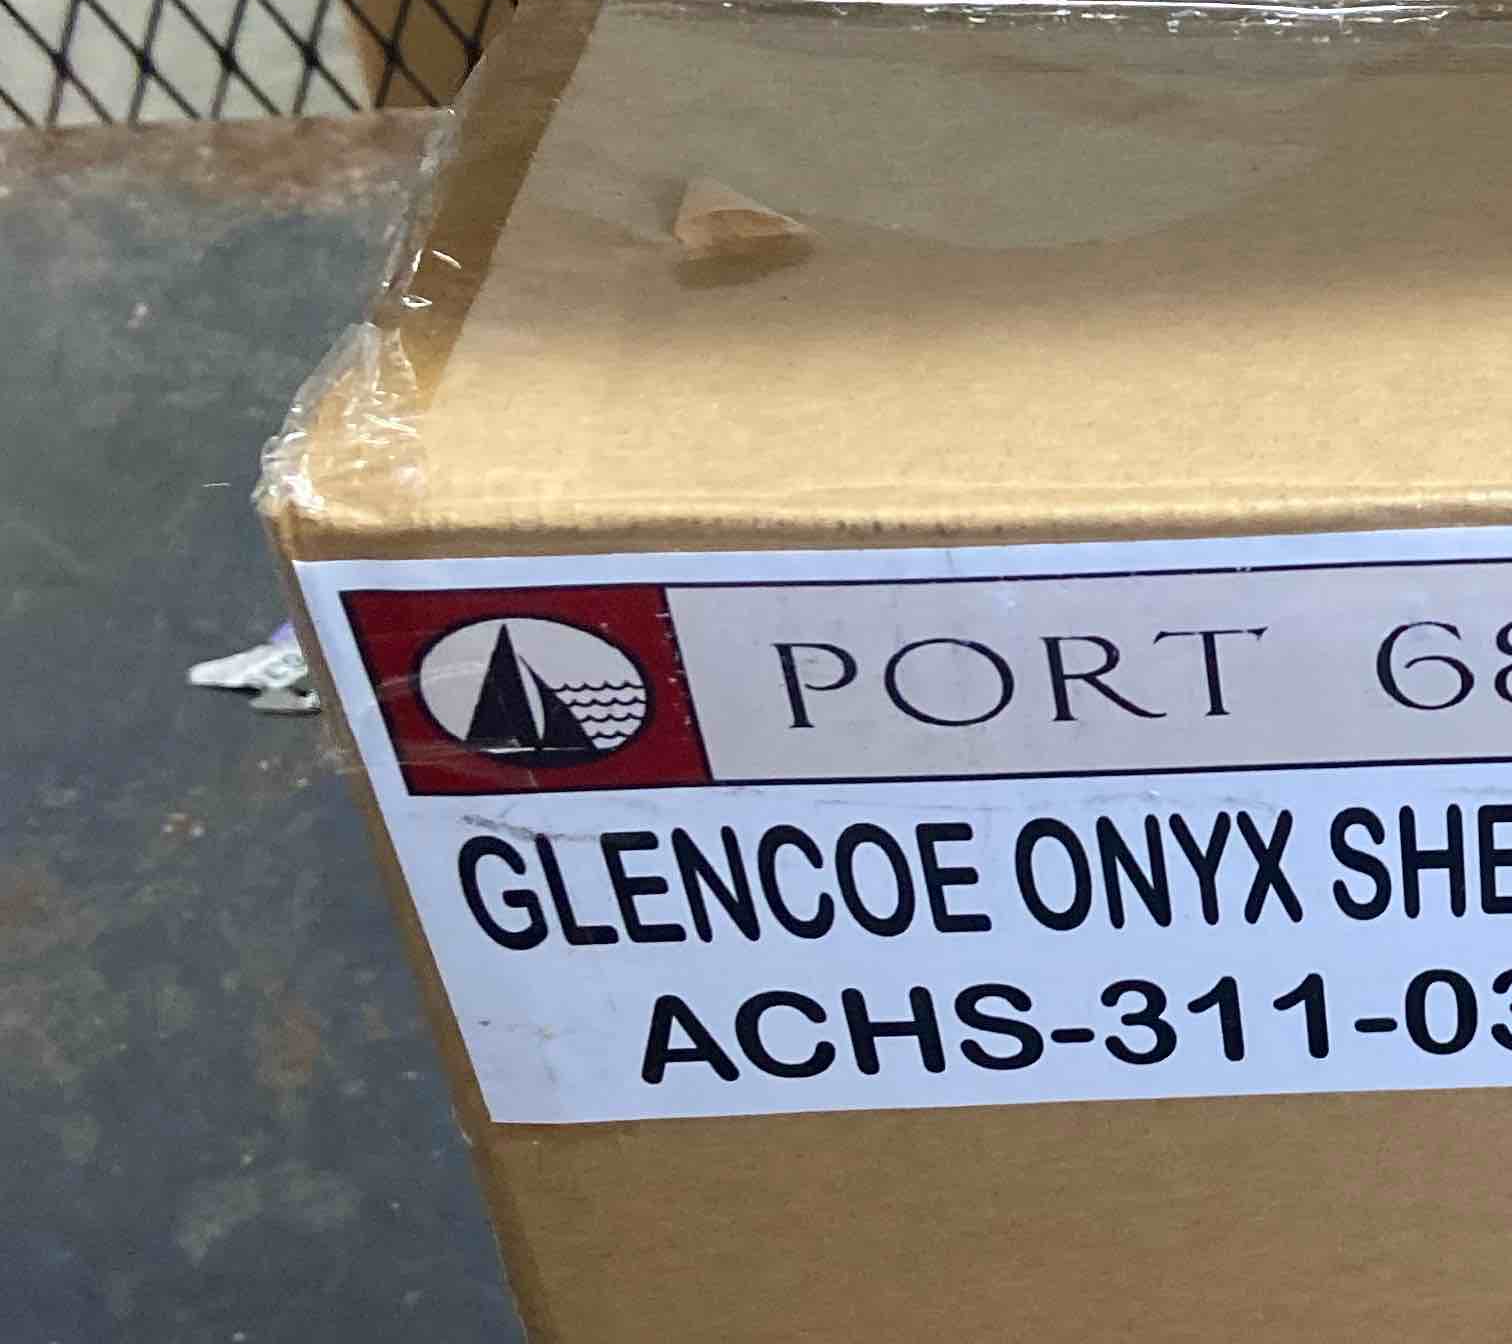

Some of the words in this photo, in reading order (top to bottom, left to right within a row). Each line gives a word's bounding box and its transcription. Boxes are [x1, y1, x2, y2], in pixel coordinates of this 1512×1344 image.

[772, 627, 1264, 729] PORT
[457, 821, 993, 951] GLENCOE
[1014, 808, 1303, 932] ONYX
